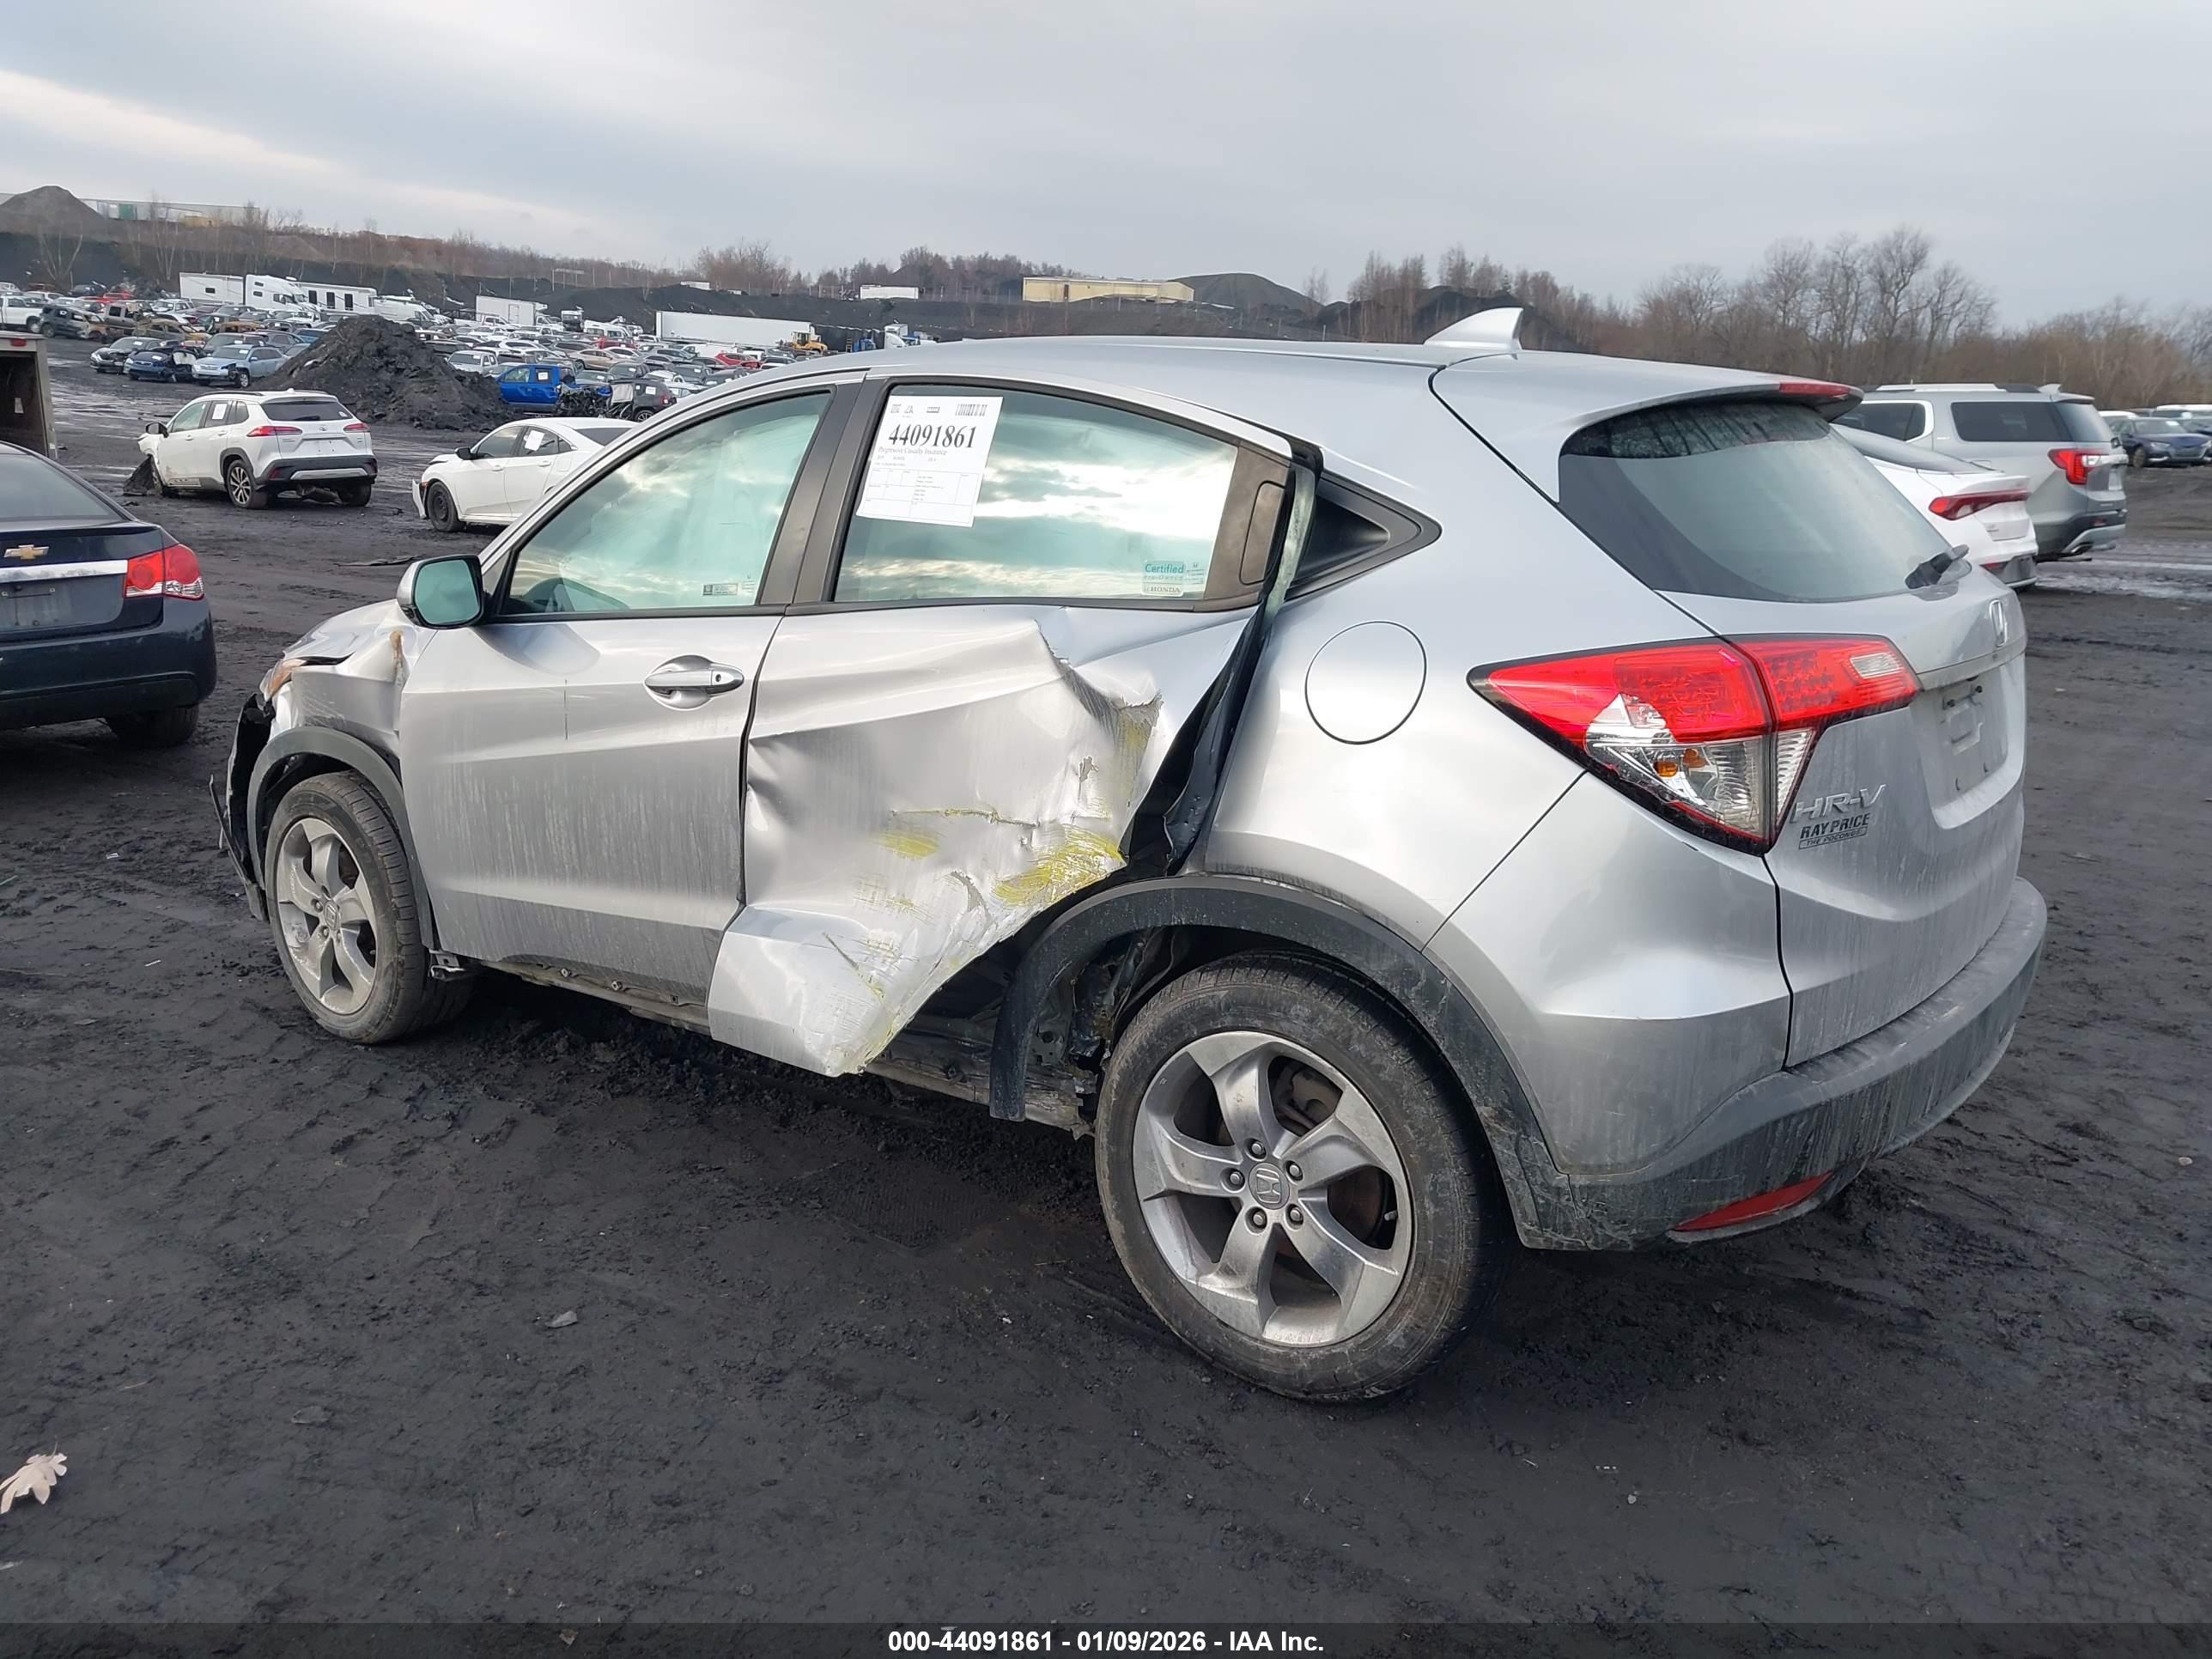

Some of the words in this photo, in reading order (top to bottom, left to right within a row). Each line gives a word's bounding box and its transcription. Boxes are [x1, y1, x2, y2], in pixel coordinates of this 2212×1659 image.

[889, 423, 976, 448] 44091861
[1145, 563, 1184, 574] Certified
[1791, 784, 1887, 822] HR-V
[1800, 822, 1829, 839] RAY
[1830, 812, 1871, 832] PRICE
